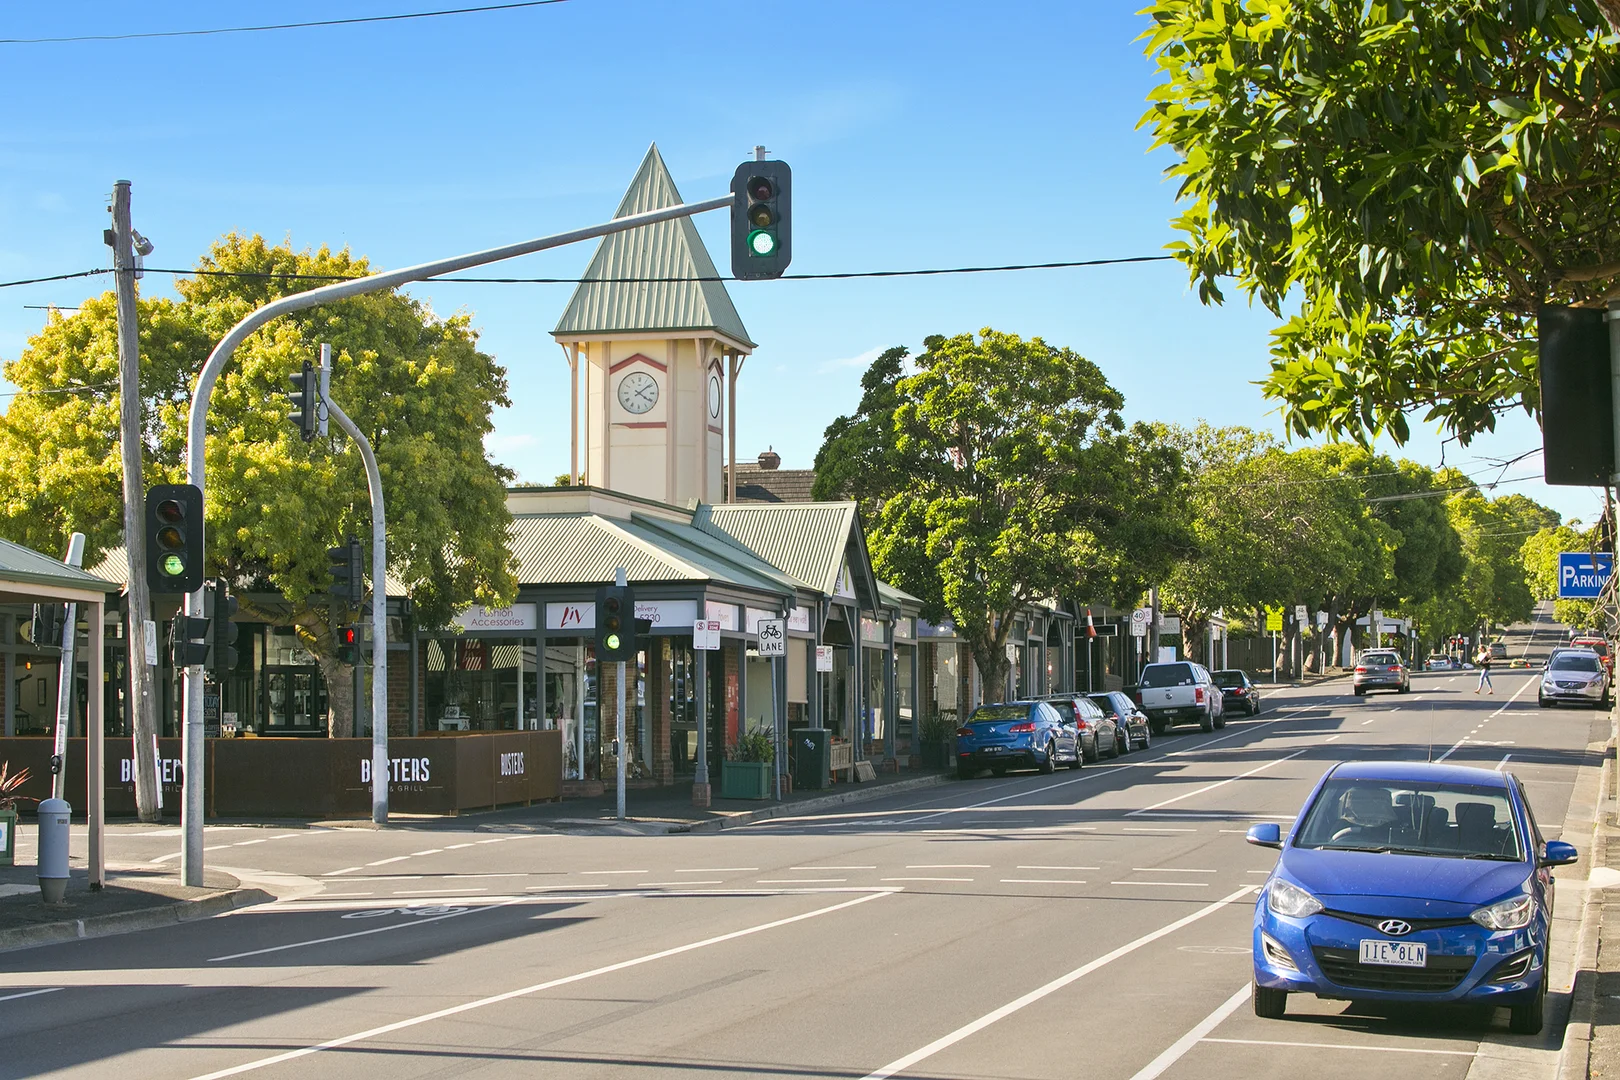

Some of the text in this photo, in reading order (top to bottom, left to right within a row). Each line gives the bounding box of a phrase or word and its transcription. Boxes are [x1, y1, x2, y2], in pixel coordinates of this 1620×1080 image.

[471, 619, 524, 627] Accessories
[760, 642, 782, 652] LANE
[1399, 946, 1424, 962] 8LN
